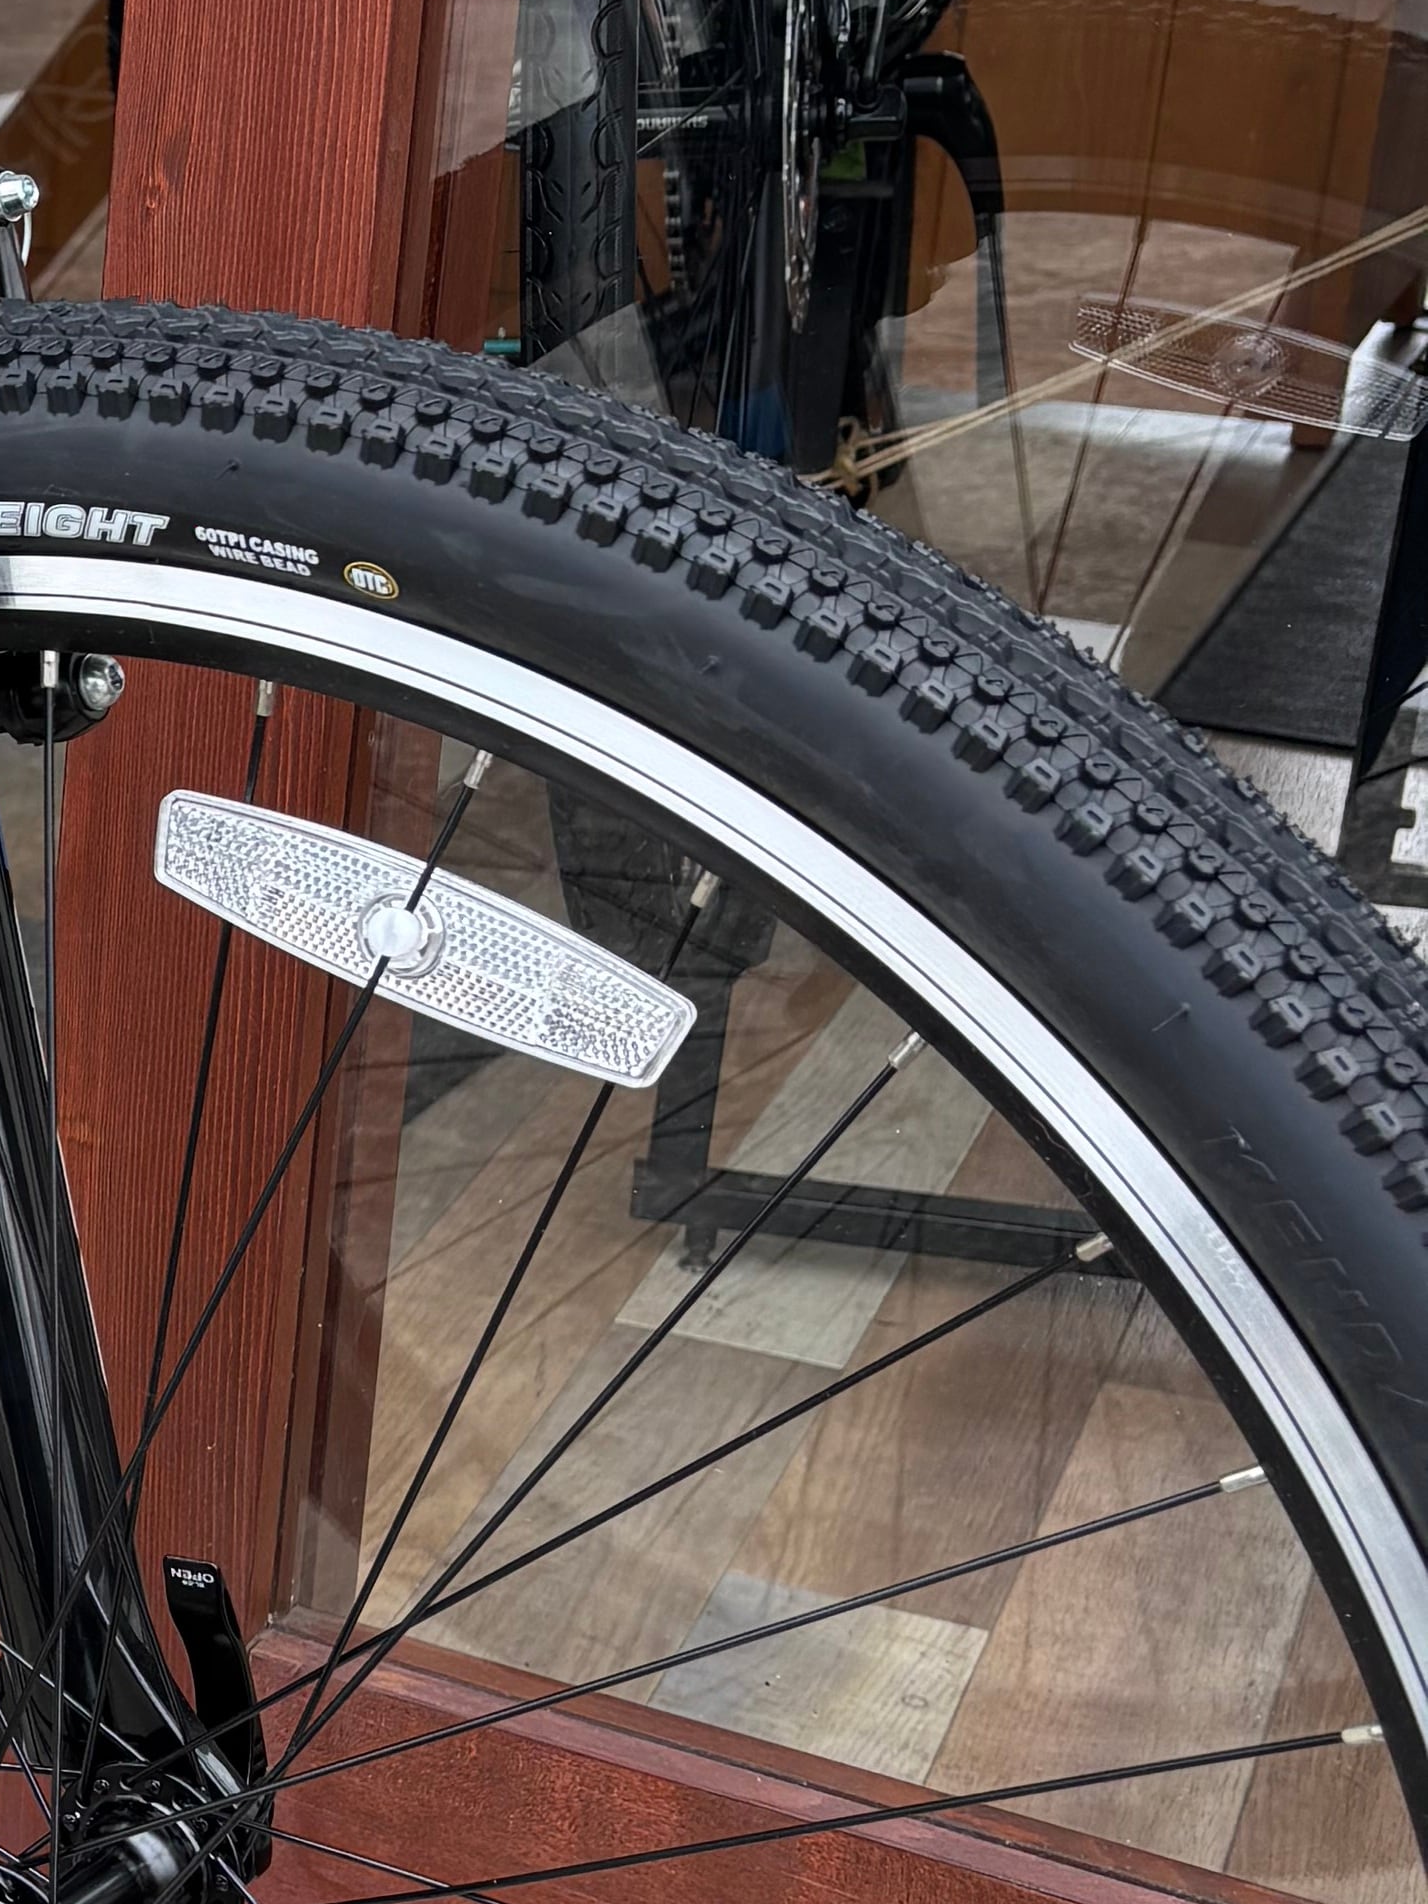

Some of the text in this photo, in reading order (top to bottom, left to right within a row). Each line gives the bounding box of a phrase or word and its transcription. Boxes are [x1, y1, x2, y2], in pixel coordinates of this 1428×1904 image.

[194, 526, 320, 565] 60TPI CASING
[208, 543, 312, 577] WIRE BEAD
[170, 1567, 214, 1583] OPEN
